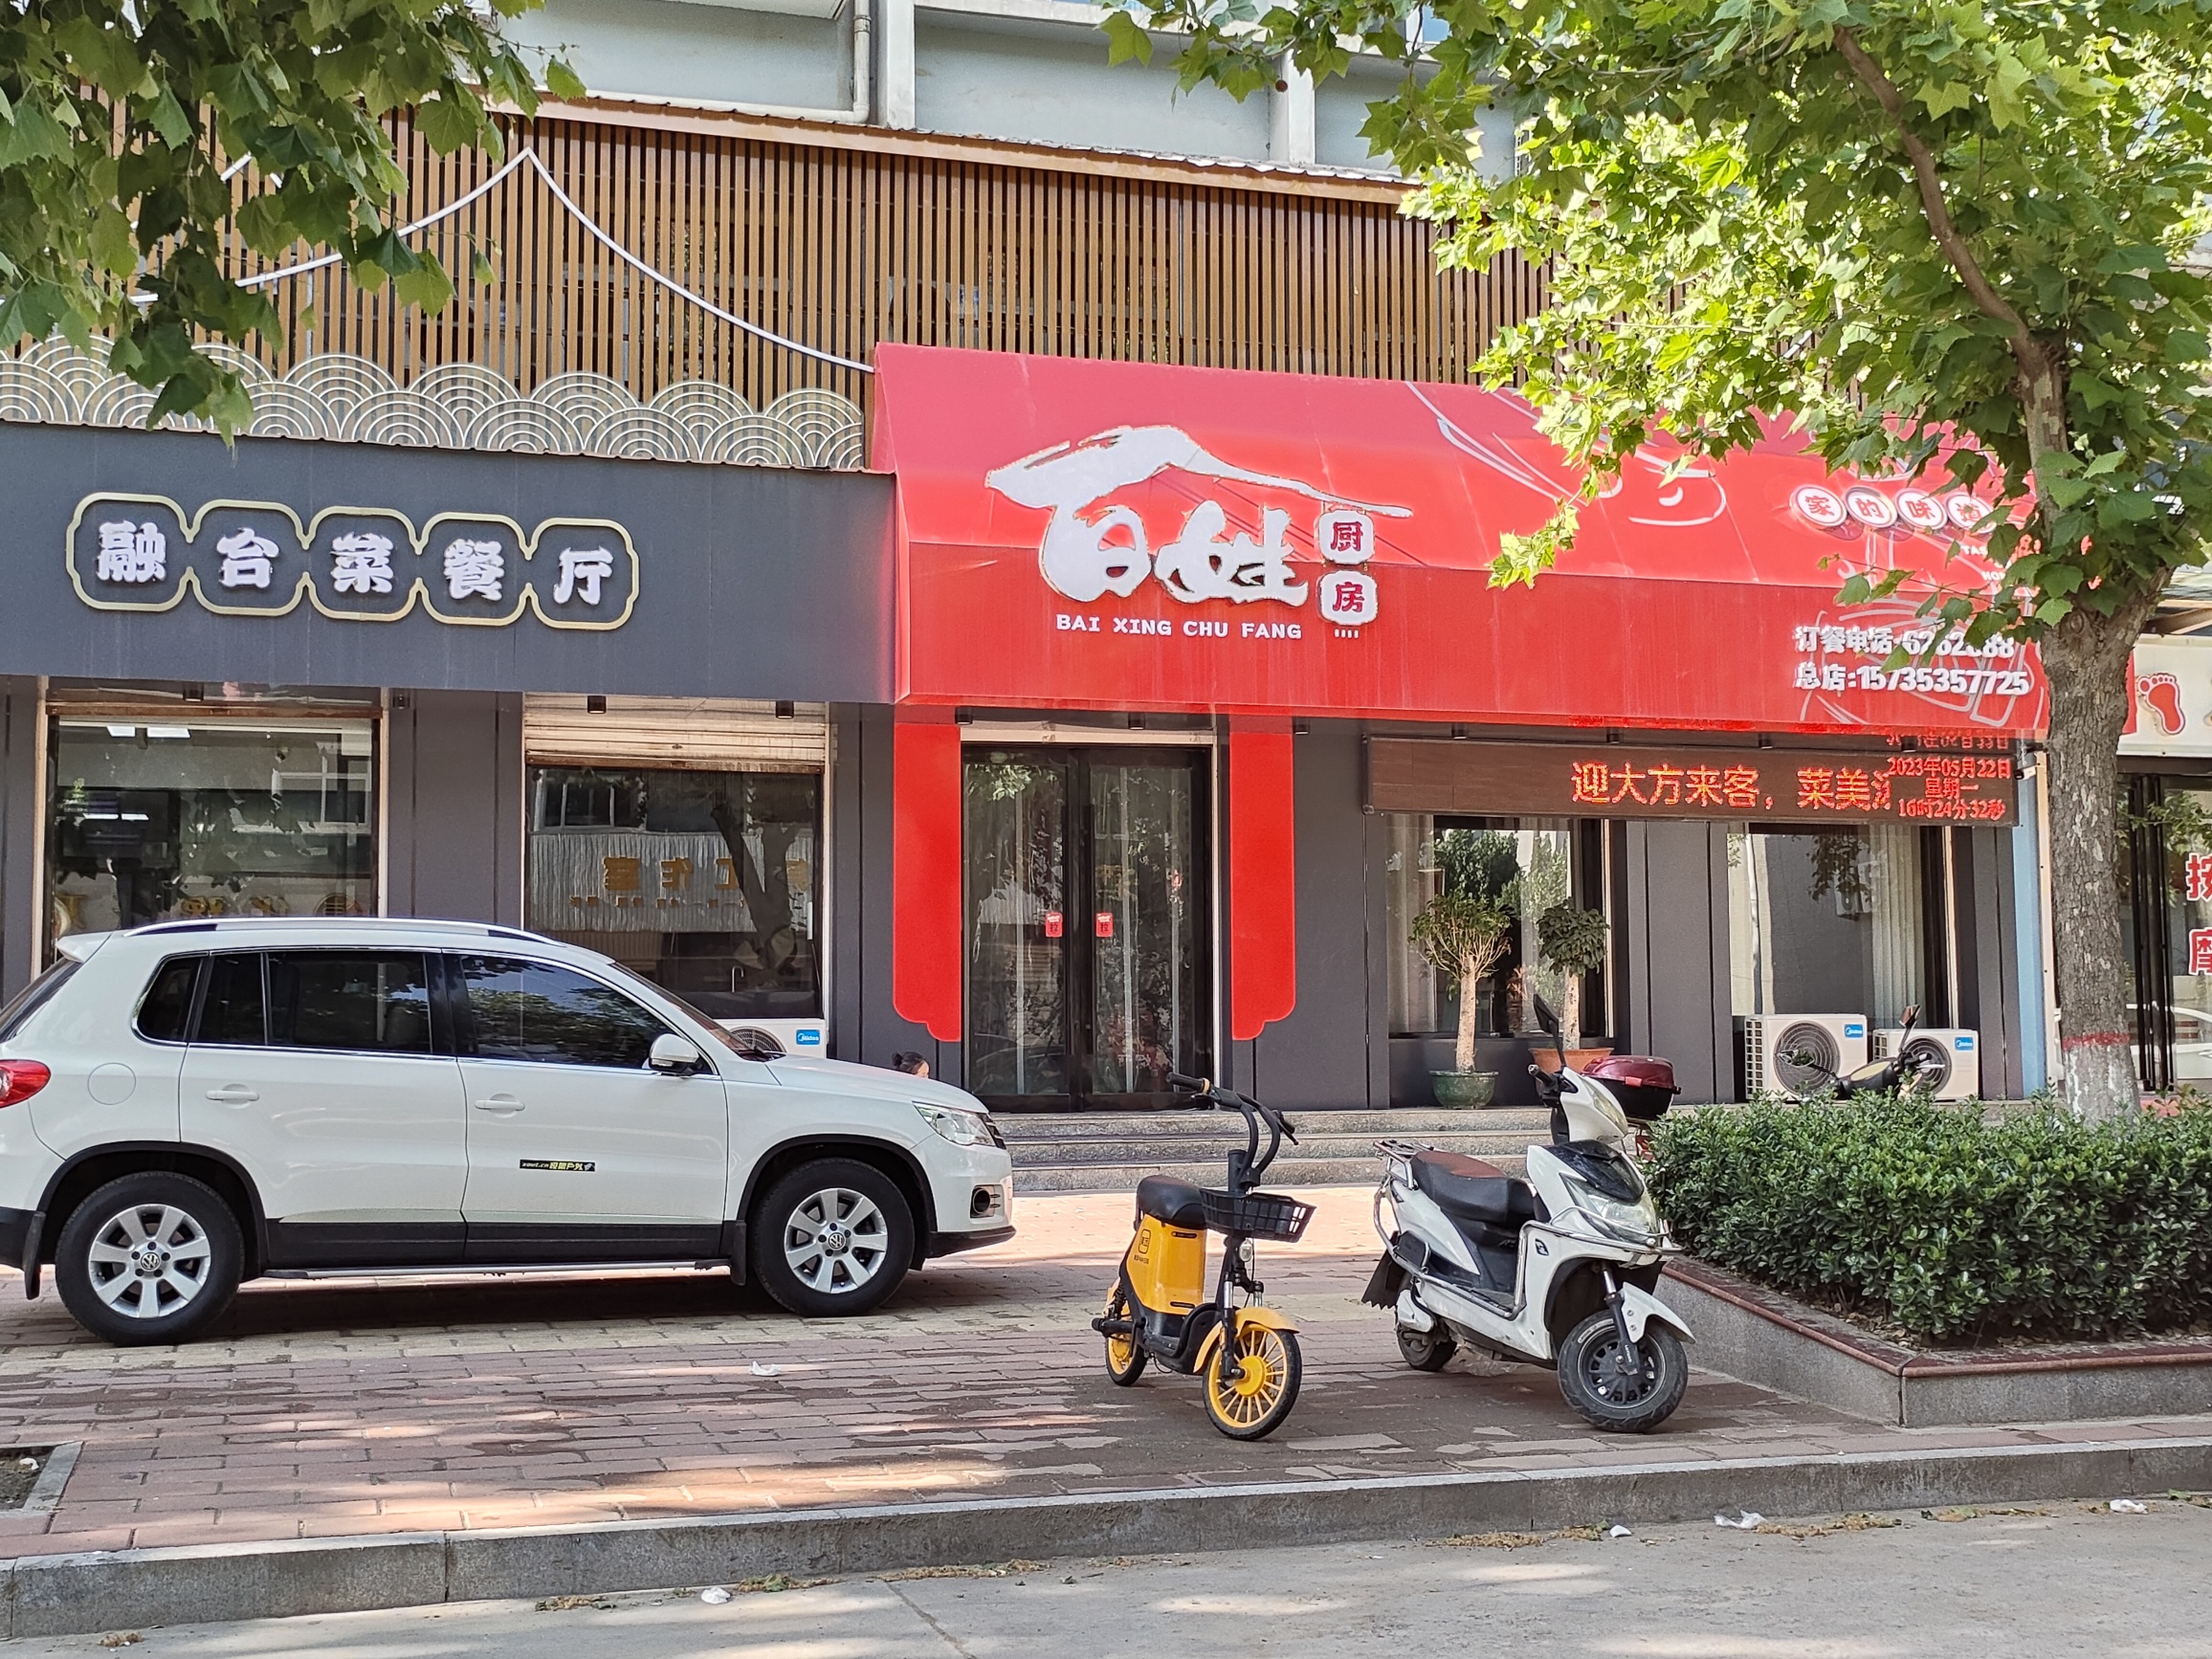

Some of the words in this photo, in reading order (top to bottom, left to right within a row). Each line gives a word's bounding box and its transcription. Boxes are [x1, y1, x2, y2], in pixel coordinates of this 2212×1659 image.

[985, 425, 1413, 607] 百姓
[1804, 494, 1984, 523] 家的味道
[97, 520, 614, 606] 融合菜餐厅
[1330, 520, 1365, 613] 厨房
[1055, 613, 1100, 632] BAI
[1113, 616, 1172, 637] XING
[1183, 620, 1228, 638] CHU
[1241, 622, 1302, 640] FANG
[1793, 661, 2030, 696] 总店:15735357725
[1887, 756, 2011, 779] 2023年05月22日
[1925, 777, 1979, 800] 星期一
[1898, 798, 2006, 821] 16时24分32秒
